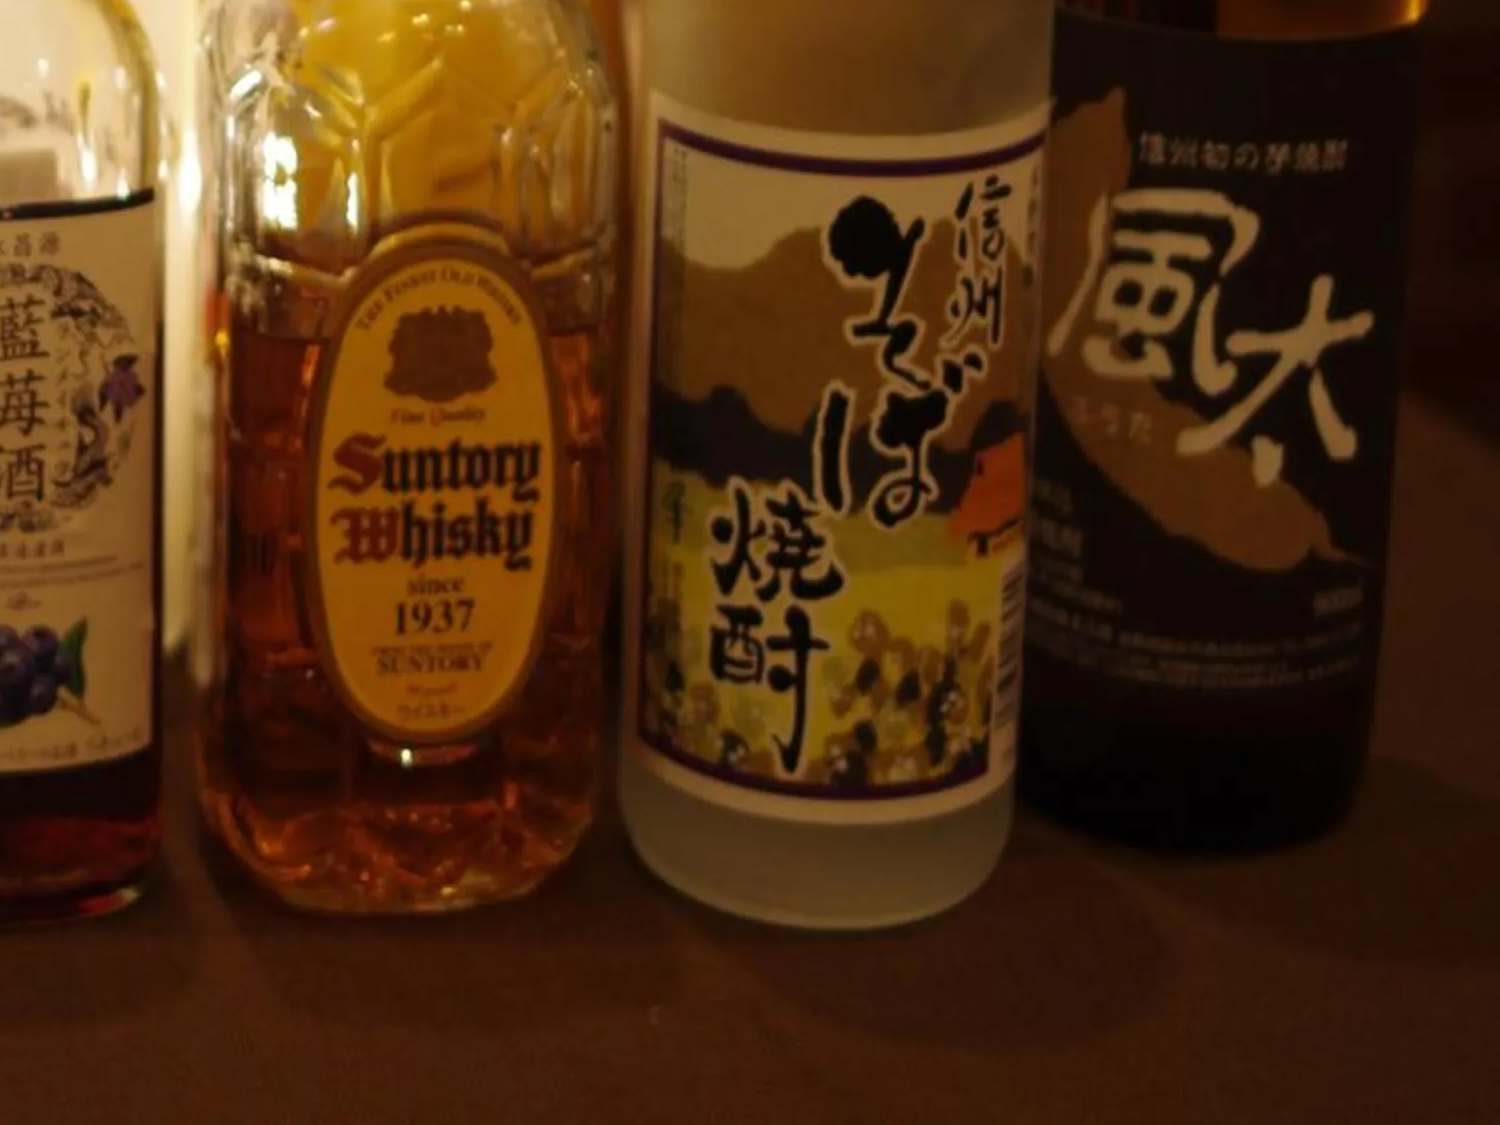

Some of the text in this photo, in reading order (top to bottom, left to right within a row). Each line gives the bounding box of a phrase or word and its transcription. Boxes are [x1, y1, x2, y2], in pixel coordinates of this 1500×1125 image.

[1047, 187, 1374, 488] 風太
[327, 430, 540, 503] Suntory
[329, 497, 536, 572] Whisky
[395, 598, 476, 637] 1937
[709, 483, 846, 772] 焼酎
